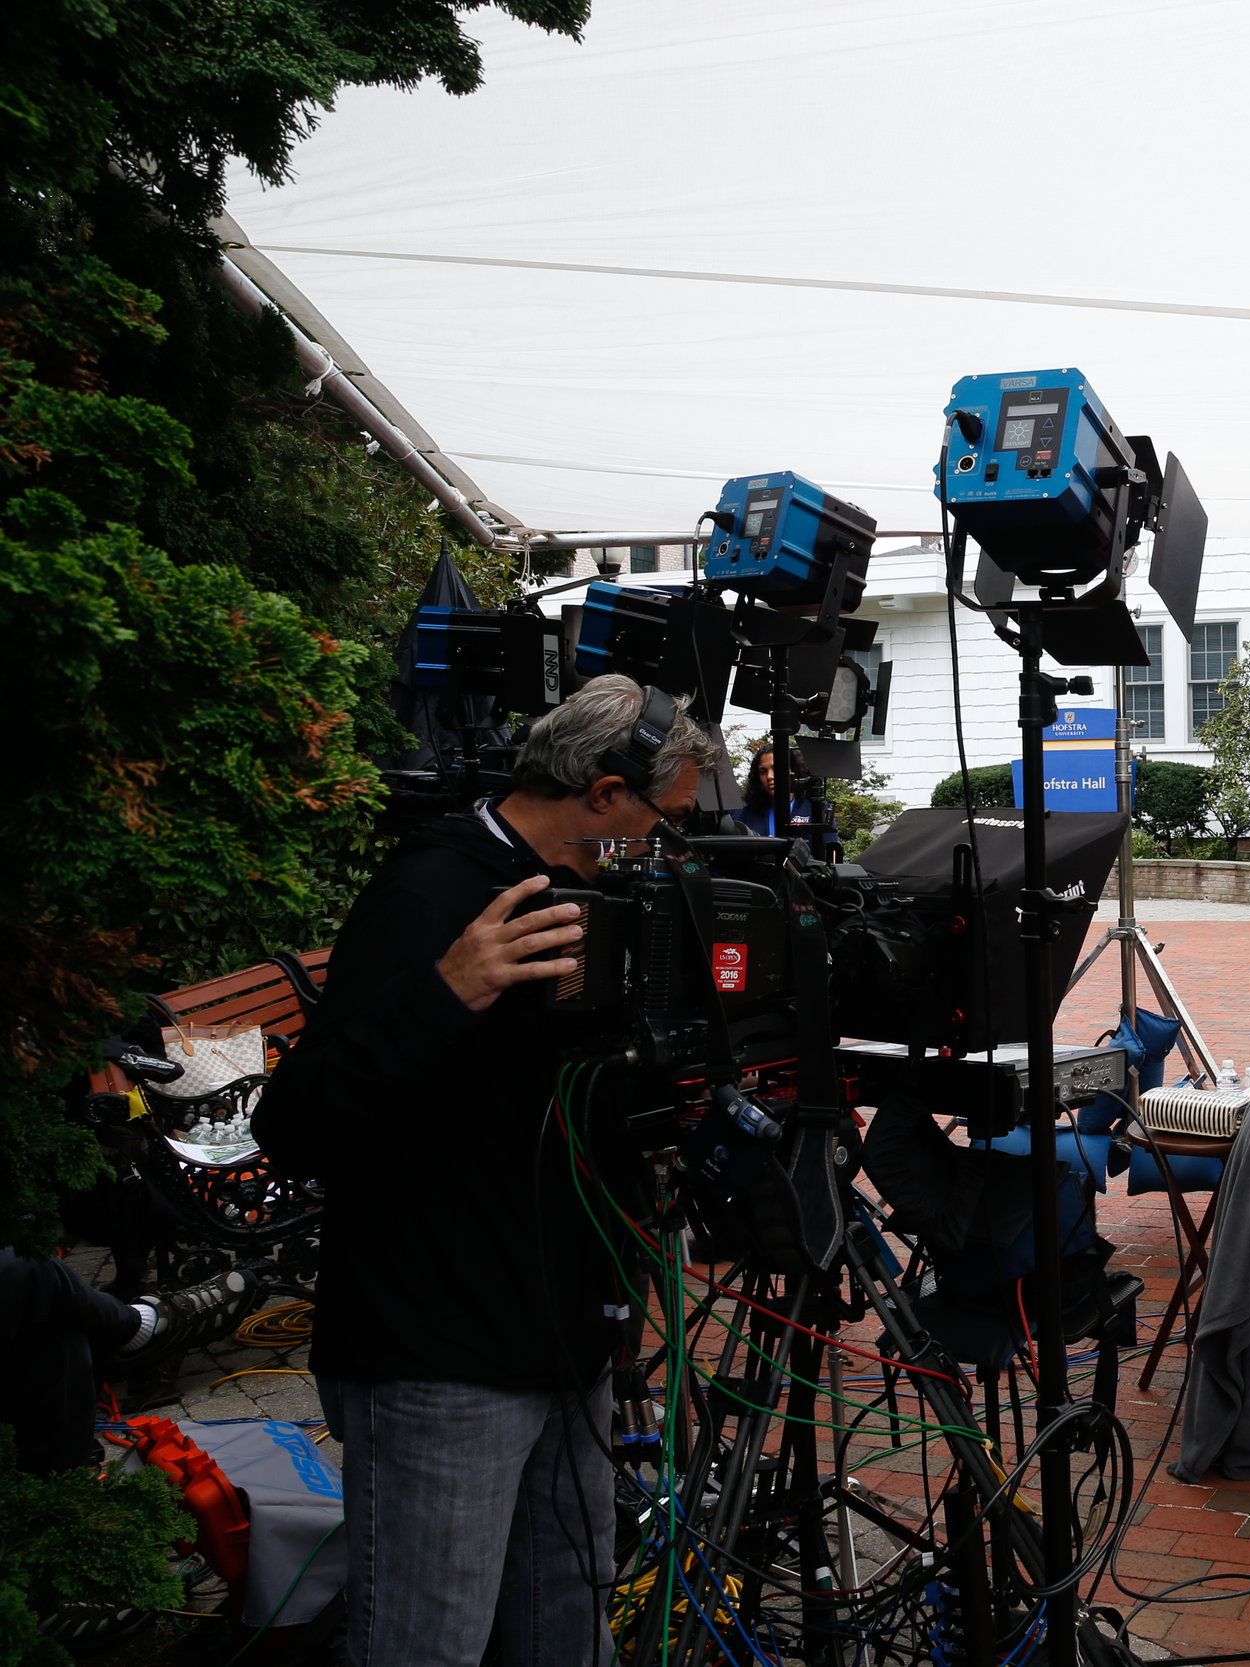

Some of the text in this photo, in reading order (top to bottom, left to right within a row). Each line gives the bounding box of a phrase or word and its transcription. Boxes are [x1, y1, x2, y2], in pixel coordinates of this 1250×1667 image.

[1002, 379, 1035, 388] VARSA
[545, 650, 559, 691] CNN
[1043, 777, 1106, 790] ofstra Hall
[720, 970, 739, 979] 2016
